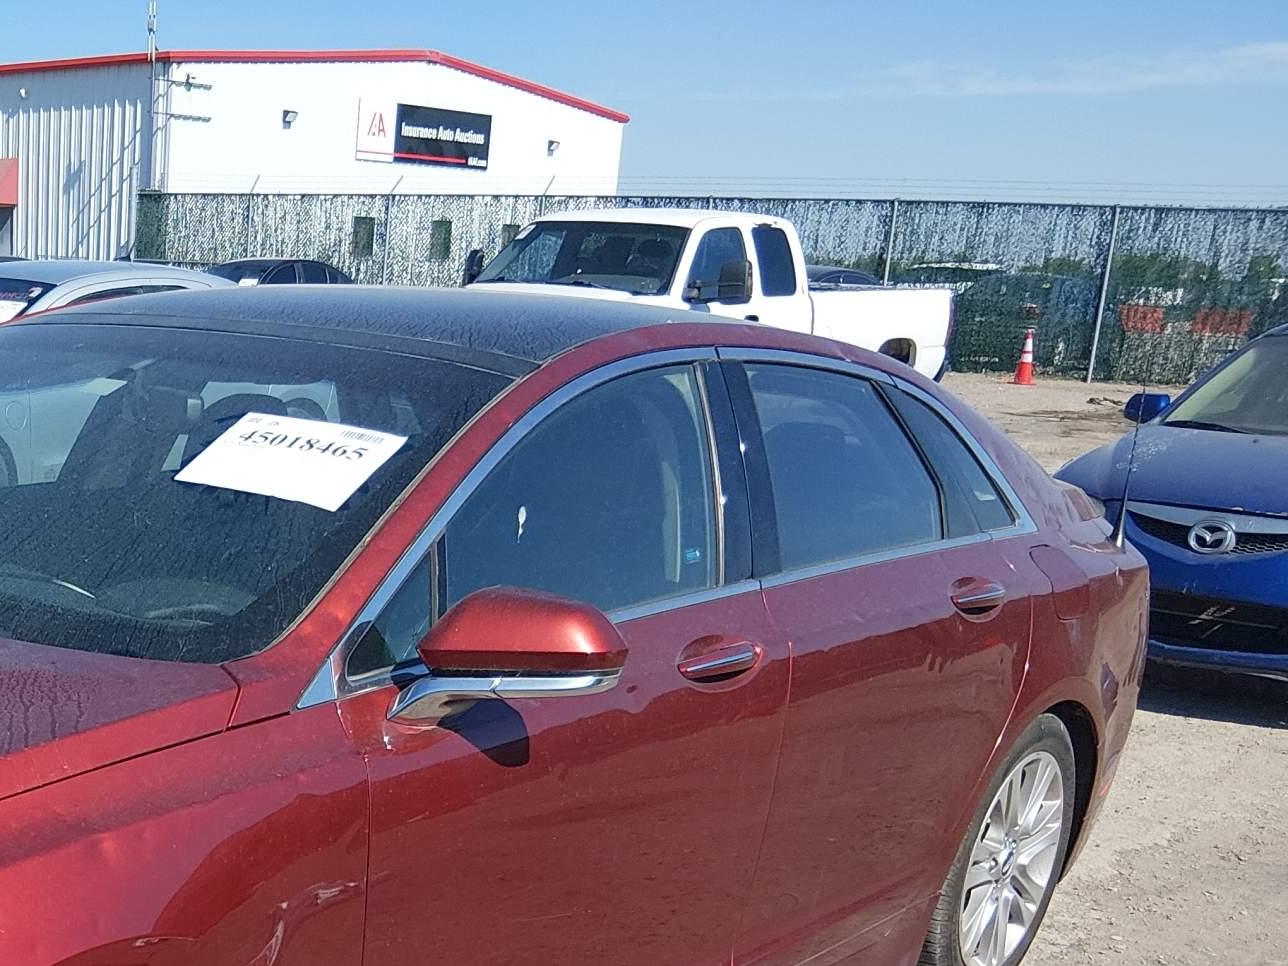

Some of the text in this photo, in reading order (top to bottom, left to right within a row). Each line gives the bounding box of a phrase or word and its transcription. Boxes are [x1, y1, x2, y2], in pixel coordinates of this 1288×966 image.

[401, 122, 485, 144] Insurance Auto Auctions
[239, 429, 369, 461] 45018465
